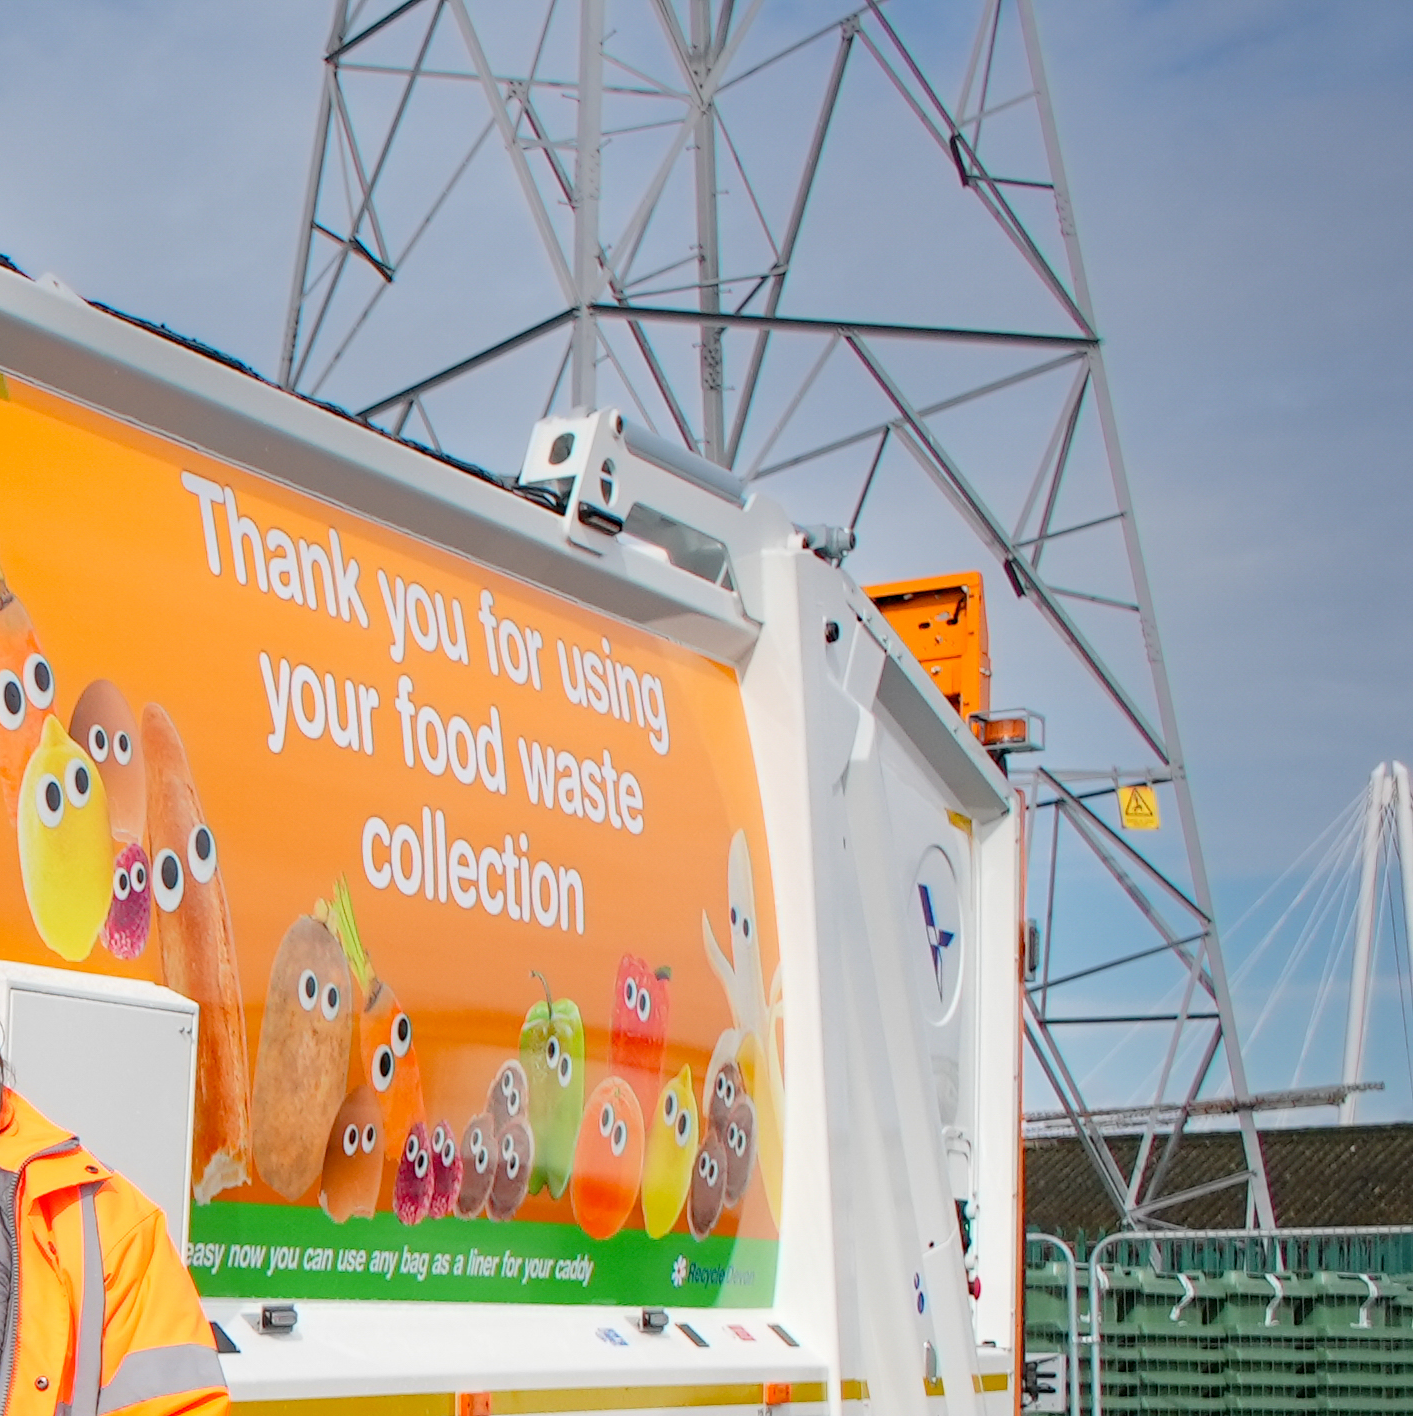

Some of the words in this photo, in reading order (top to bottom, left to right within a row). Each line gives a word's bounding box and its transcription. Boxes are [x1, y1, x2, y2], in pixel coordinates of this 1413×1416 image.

[181, 470, 370, 629] Thank
[377, 568, 469, 664] you
[478, 588, 543, 691] for
[557, 634, 670, 756] using
[259, 650, 380, 756] your
[395, 674, 508, 796] food
[518, 736, 644, 835] waste
[361, 805, 585, 936] collection
[228, 1244, 266, 1268] now
[267, 1247, 300, 1277] you
[303, 1248, 334, 1271] can
[337, 1249, 367, 1272] use
[369, 1249, 399, 1281] any
[400, 1244, 430, 1281] bag
[431, 1252, 452, 1274] as
[453, 1254, 465, 1275] a
[467, 1248, 500, 1277] liner
[501, 1250, 523, 1277] for
[522, 1257, 554, 1285] your
[555, 1253, 594, 1287] caddy
